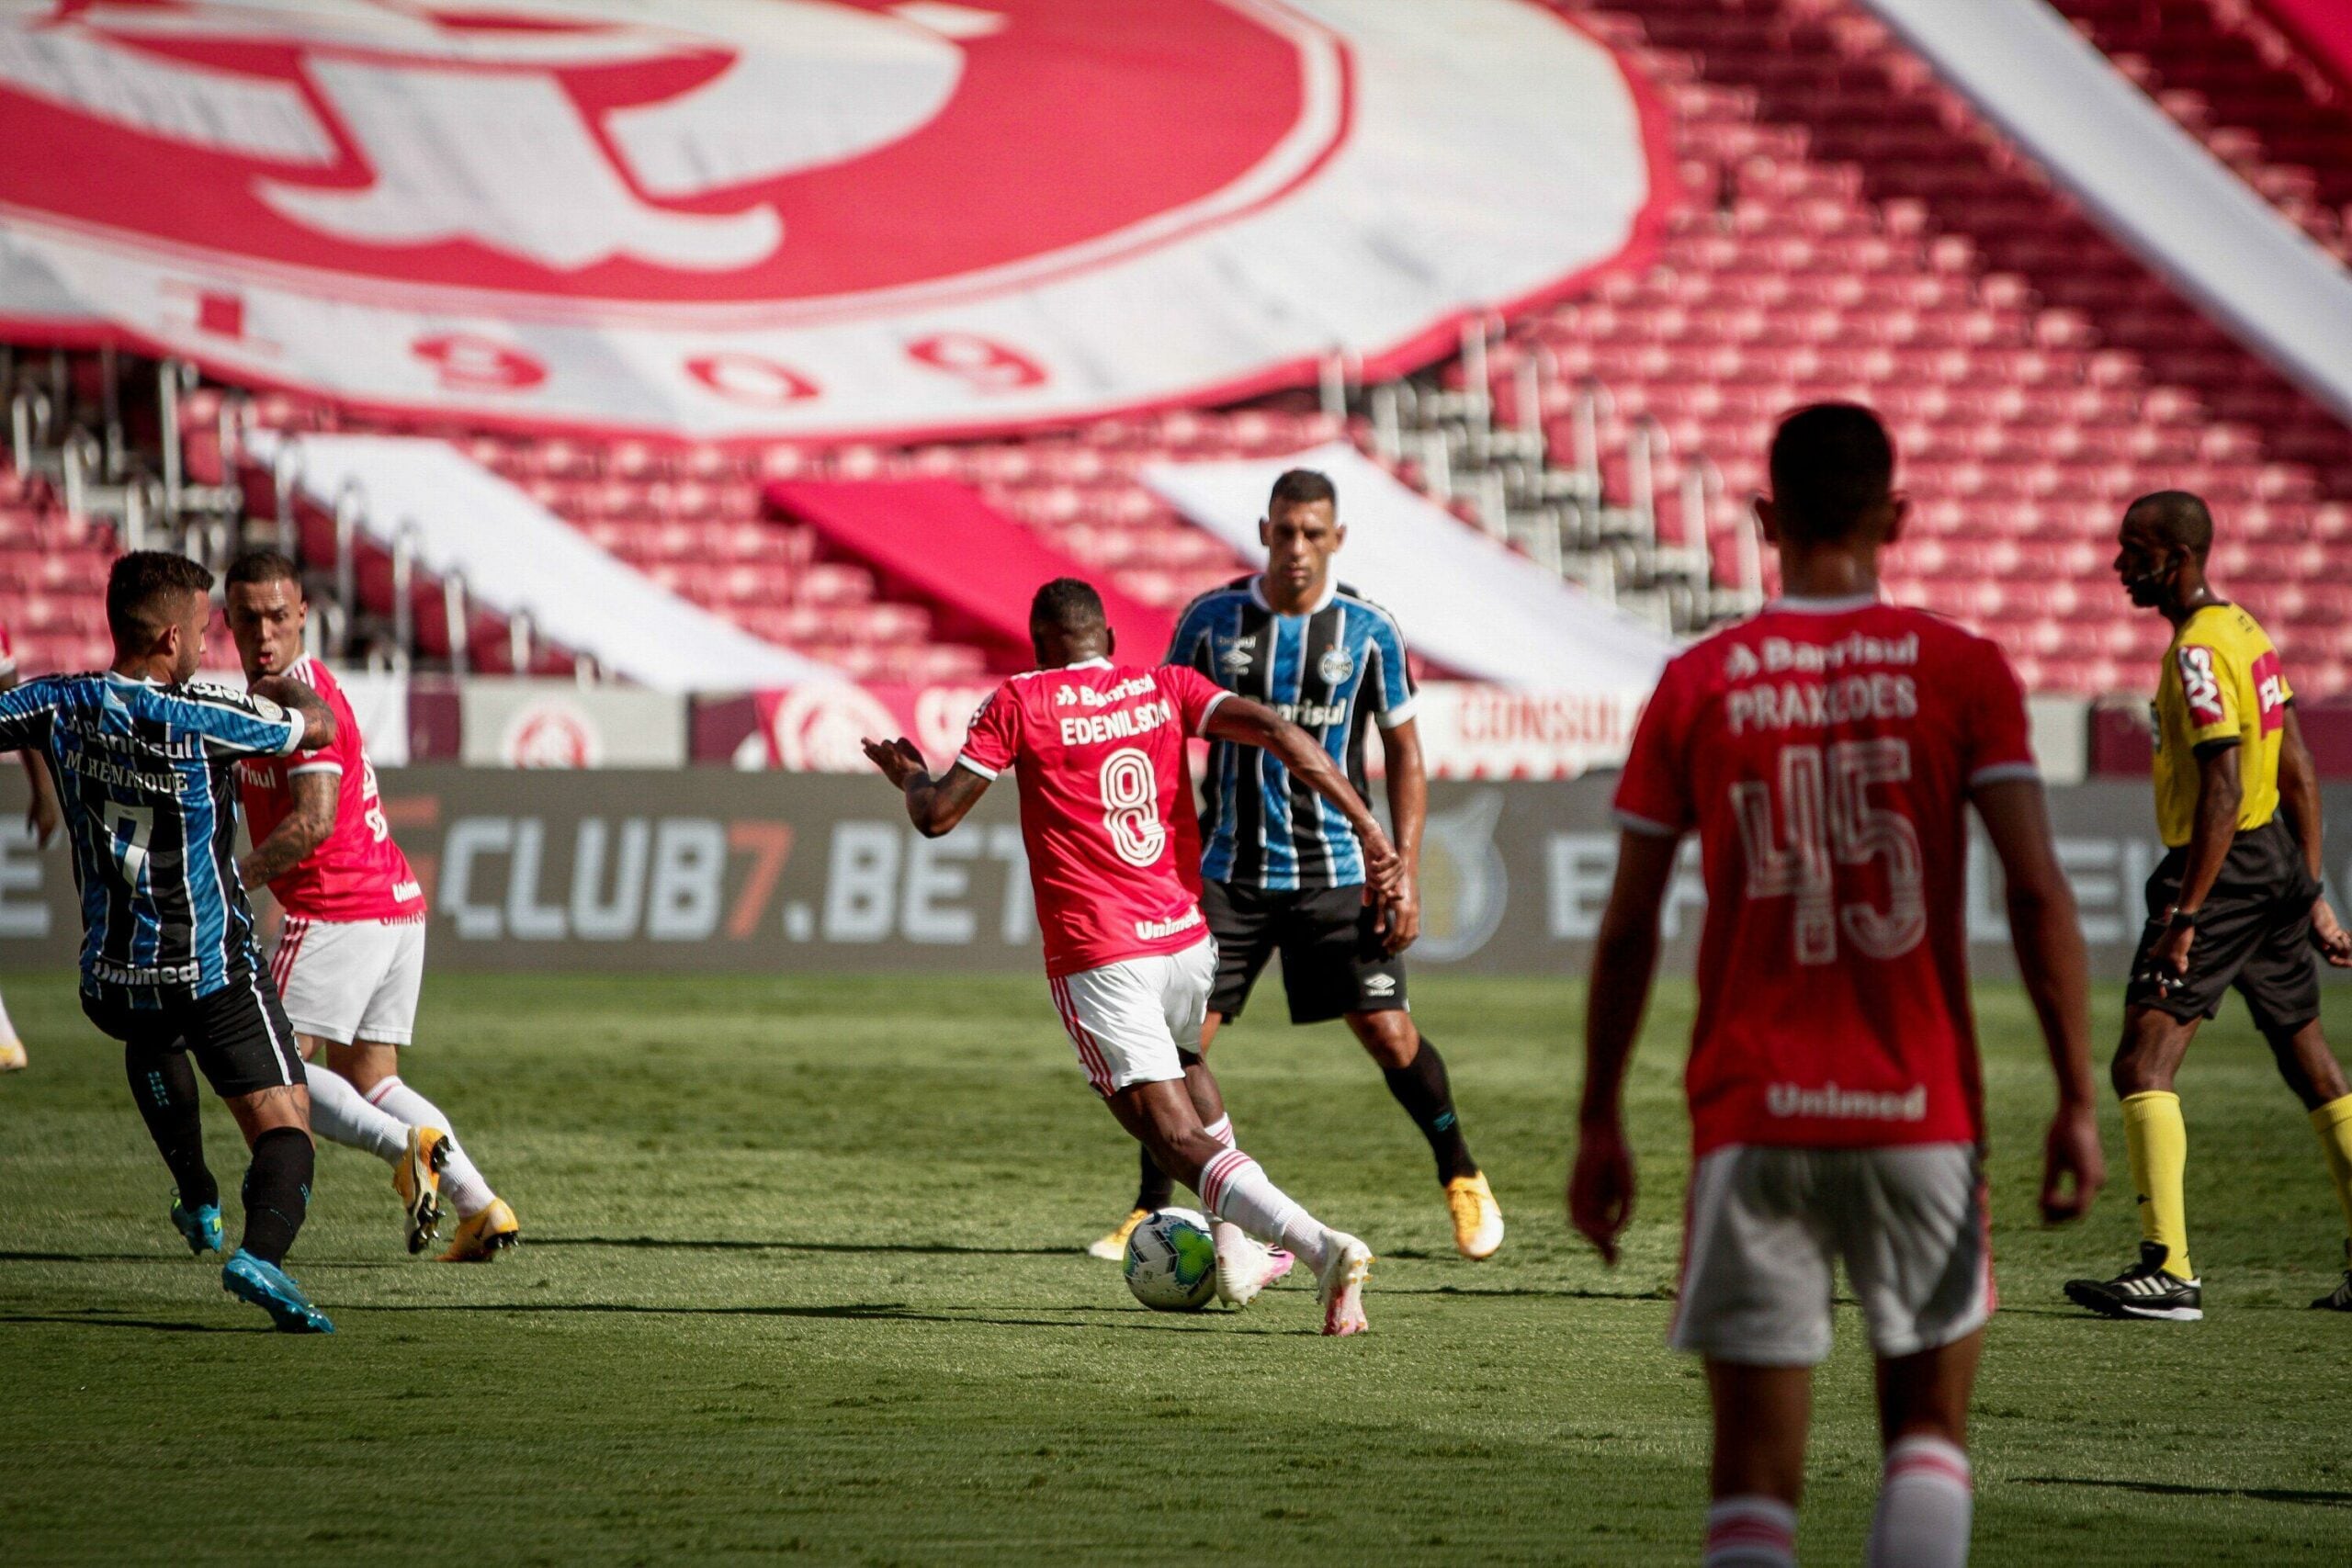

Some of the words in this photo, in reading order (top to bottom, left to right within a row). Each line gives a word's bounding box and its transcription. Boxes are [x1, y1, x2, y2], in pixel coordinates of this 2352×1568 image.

[1763, 630, 1919, 673] Banrisul
[2178, 646, 2223, 716] SKY
[1059, 698, 1171, 746] EDENILSON
[1268, 696, 1348, 726] nrisul
[1100, 748, 1166, 867] 8
[104, 800, 153, 898] 7
[1728, 737, 1927, 964] 45
[94, 959, 199, 985] Unimed
[1766, 1079, 1928, 1122] Unimed
